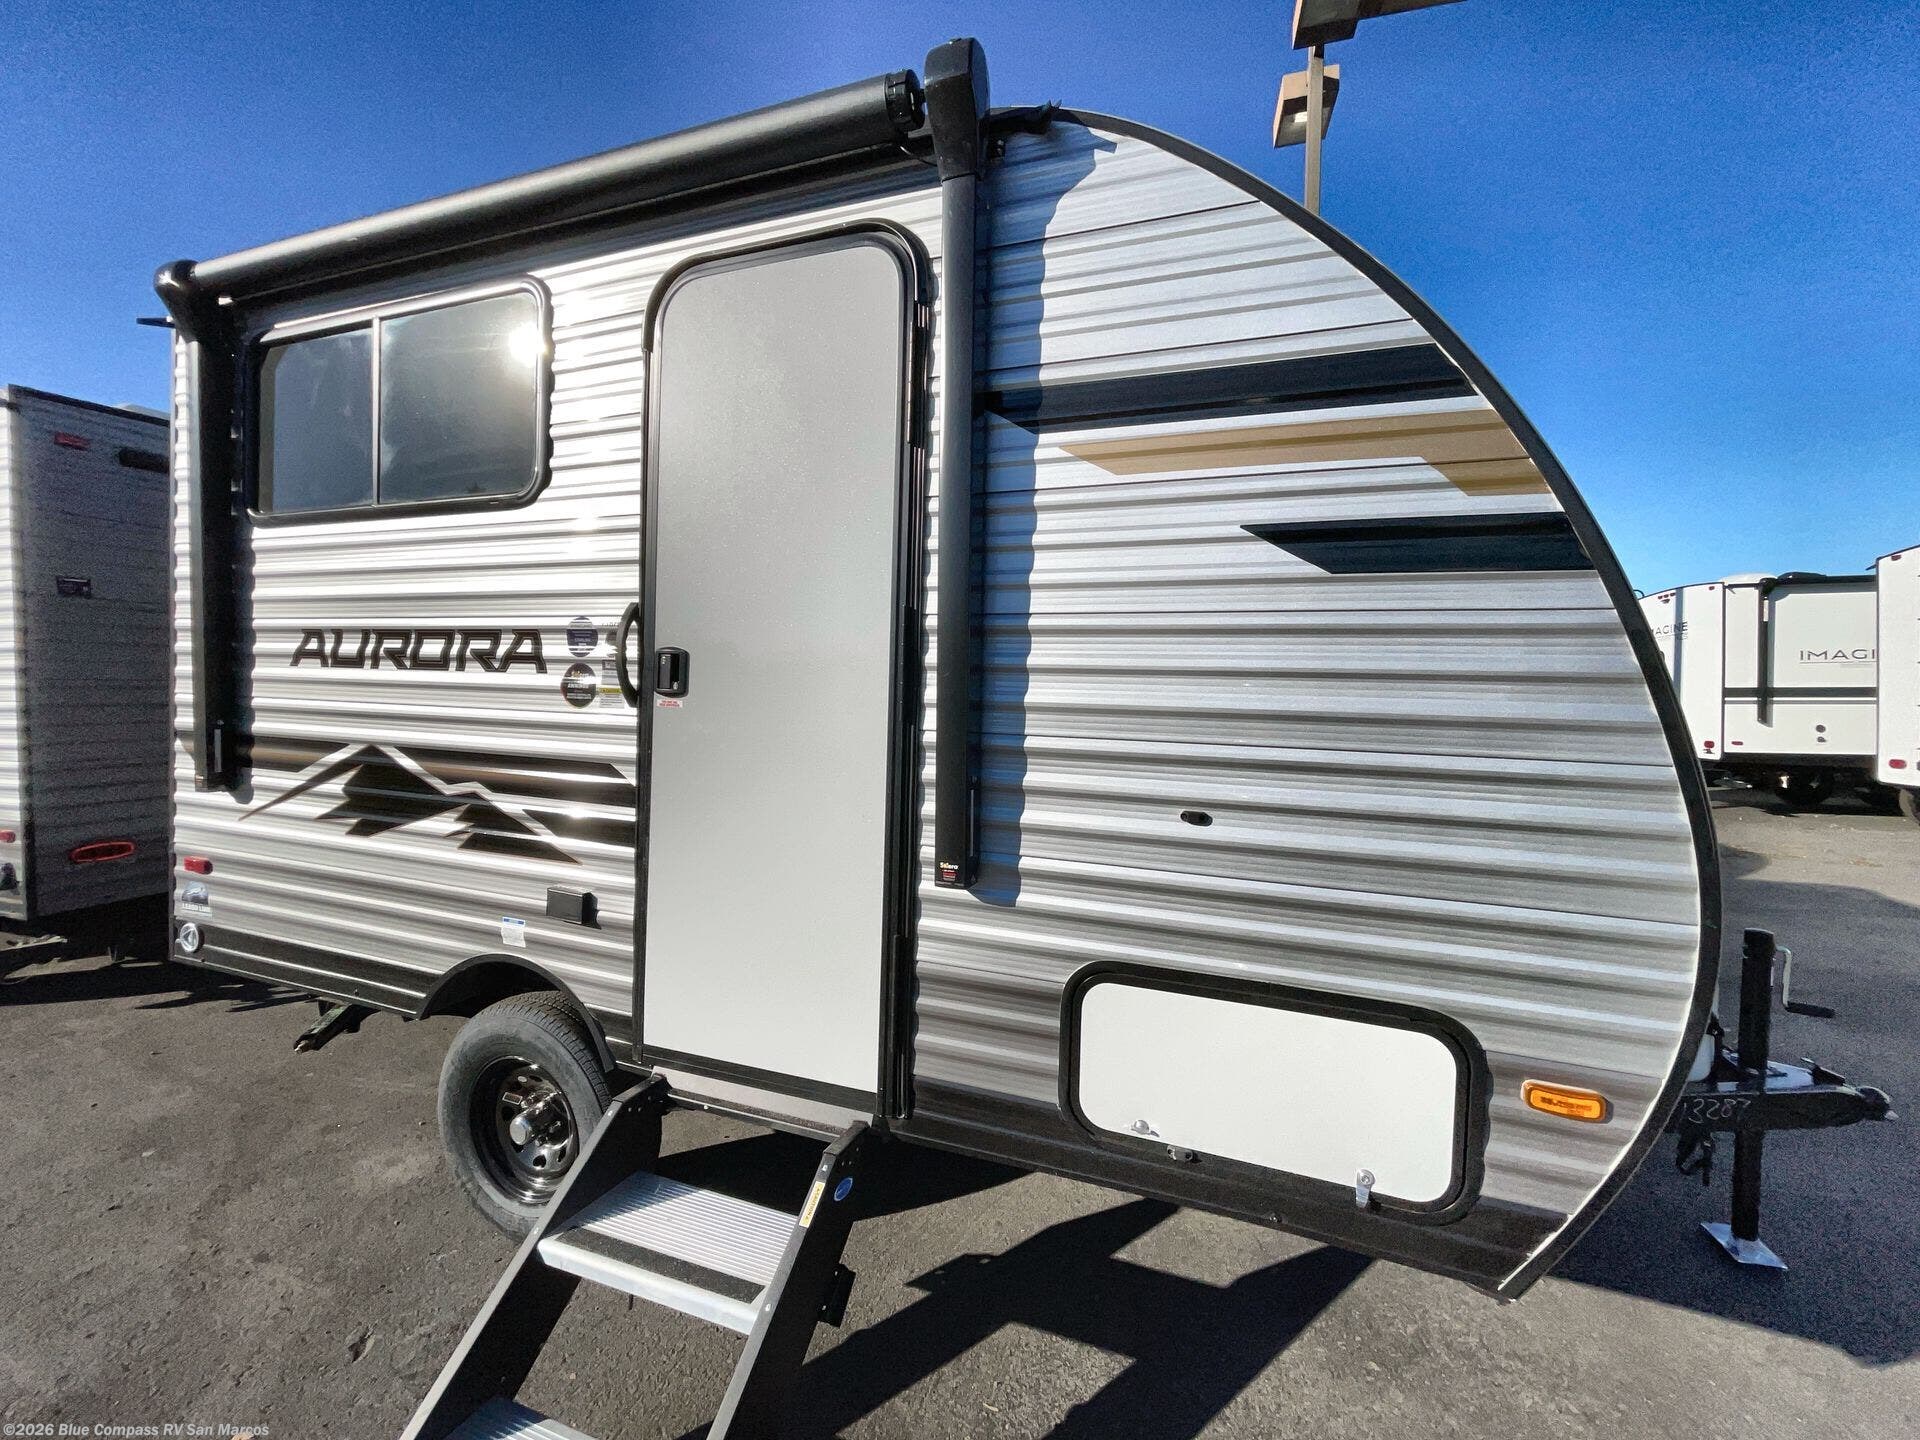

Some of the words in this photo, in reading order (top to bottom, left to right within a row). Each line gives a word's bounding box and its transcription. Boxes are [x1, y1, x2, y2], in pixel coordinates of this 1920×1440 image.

[1650, 621, 1688, 635] AGINE
[289, 628, 548, 674] AURORA
[1800, 649, 1878, 660] IMAGI
